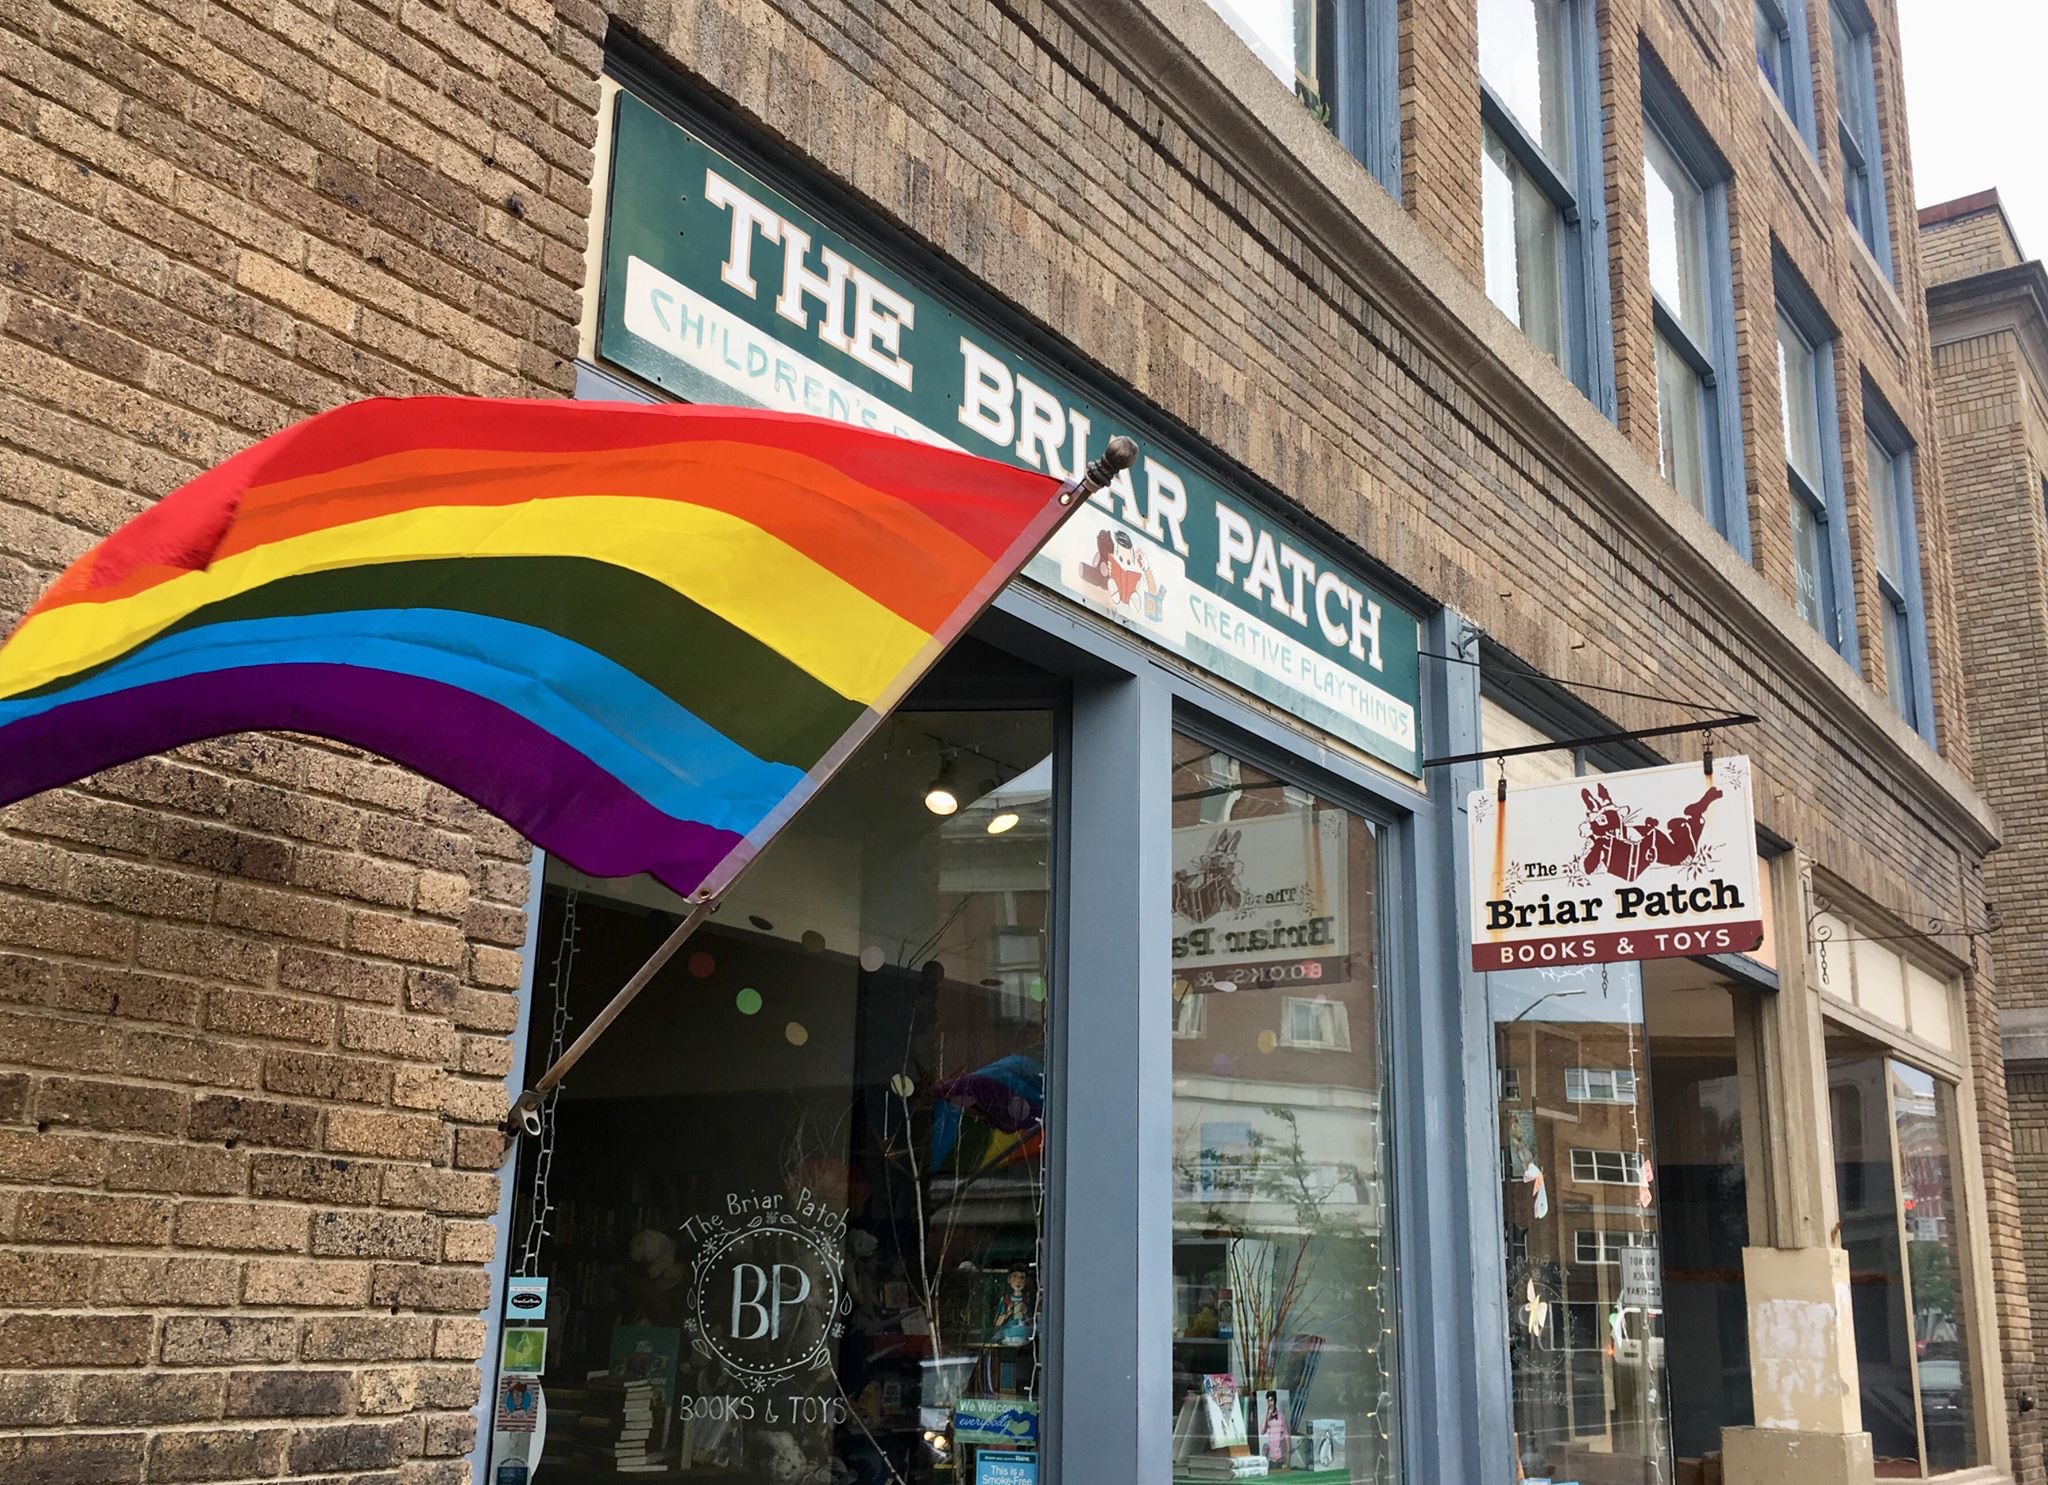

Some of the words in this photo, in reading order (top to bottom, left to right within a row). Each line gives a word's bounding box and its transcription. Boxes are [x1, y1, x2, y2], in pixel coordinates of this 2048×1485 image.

[650, 288, 877, 429] CHILDREN'S
[705, 168, 915, 392] THE
[958, 336, 1189, 557] BRIAR
[1215, 501, 1383, 673] PATCH
[1189, 594, 1293, 674] CREATIVE
[1301, 656, 1409, 736] PLAYTHINGS
[1524, 862, 1558, 879] The
[1485, 894, 1603, 931] Briar
[1615, 878, 1745, 919] Patch
[1500, 939, 1597, 964] BOOKS
[1616, 936, 1635, 956] &
[1654, 928, 1732, 952] TOYS
[678, 1214, 724, 1243] The
[726, 1188, 783, 1217] Briar
[796, 1187, 850, 1240] Patch
[730, 1263, 811, 1341] BP
[680, 1395, 755, 1422] BOOKS
[788, 1396, 848, 1425] TOYS
[960, 1400, 976, 1412] We
[977, 1401, 1024, 1415] Welcome
[991, 1464, 1009, 1476] This
[1010, 1467, 1018, 1476] is
[1019, 1468, 1025, 1477] a
